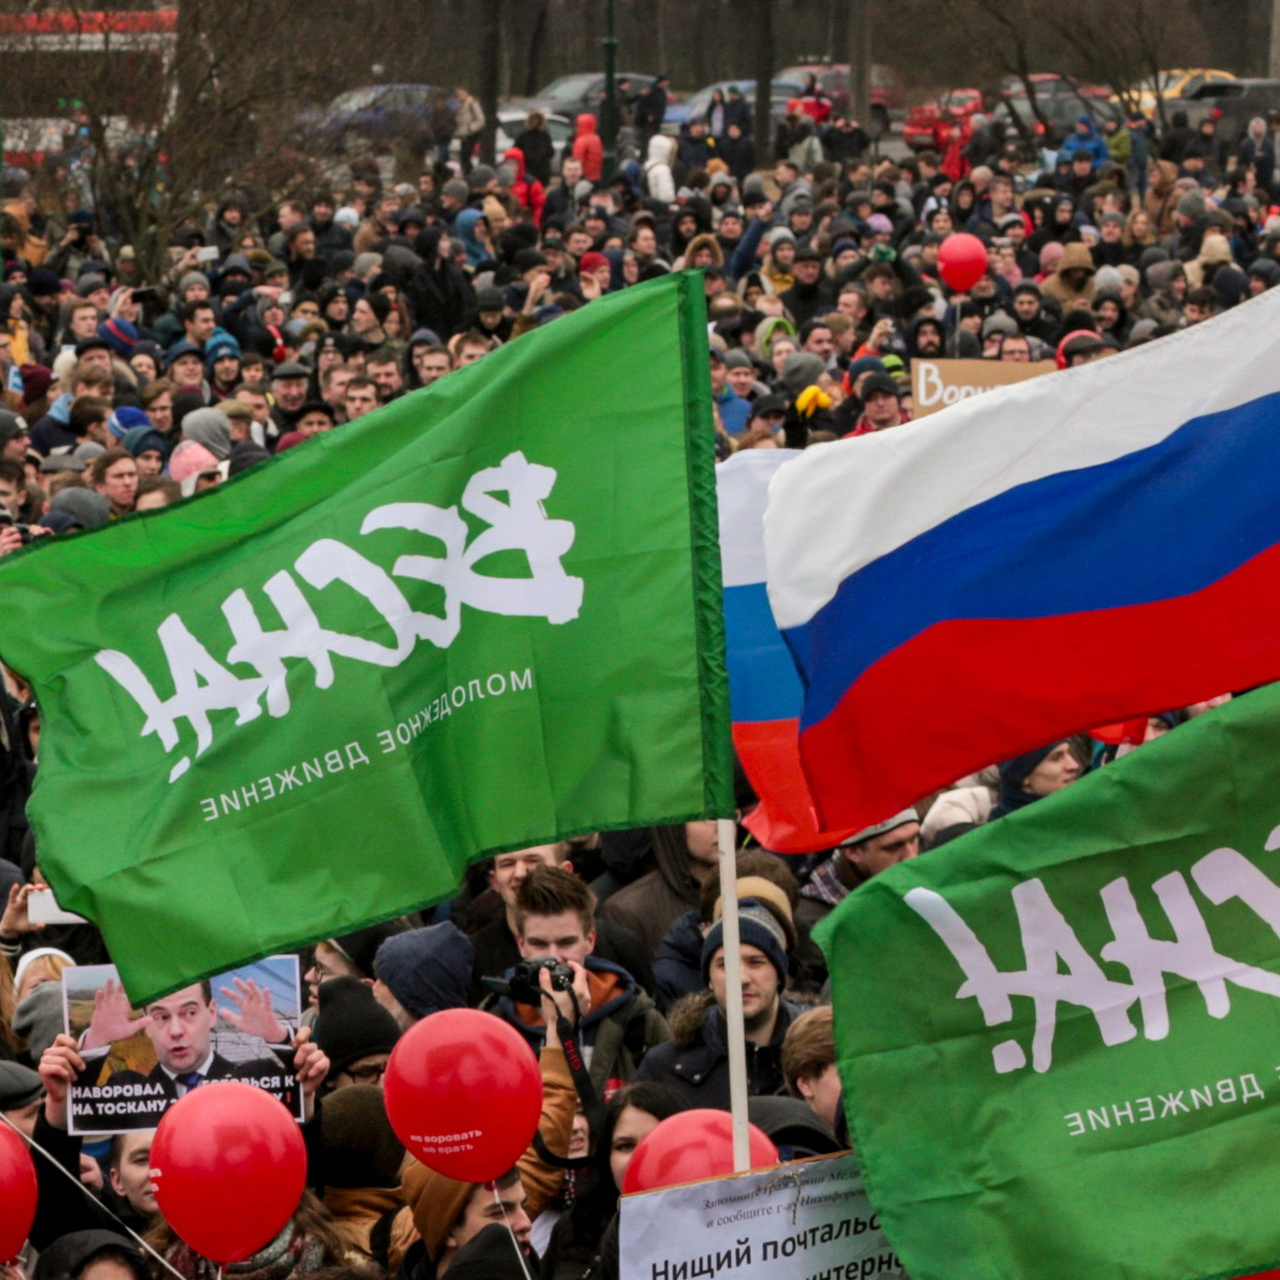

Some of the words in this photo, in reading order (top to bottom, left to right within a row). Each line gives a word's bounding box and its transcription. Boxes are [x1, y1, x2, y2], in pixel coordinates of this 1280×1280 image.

[71, 1082, 165, 1099] НАВОРОВАЛ
[71, 1103, 94, 1116] НА
[96, 1099, 167, 1115] ТОСКАНУ
